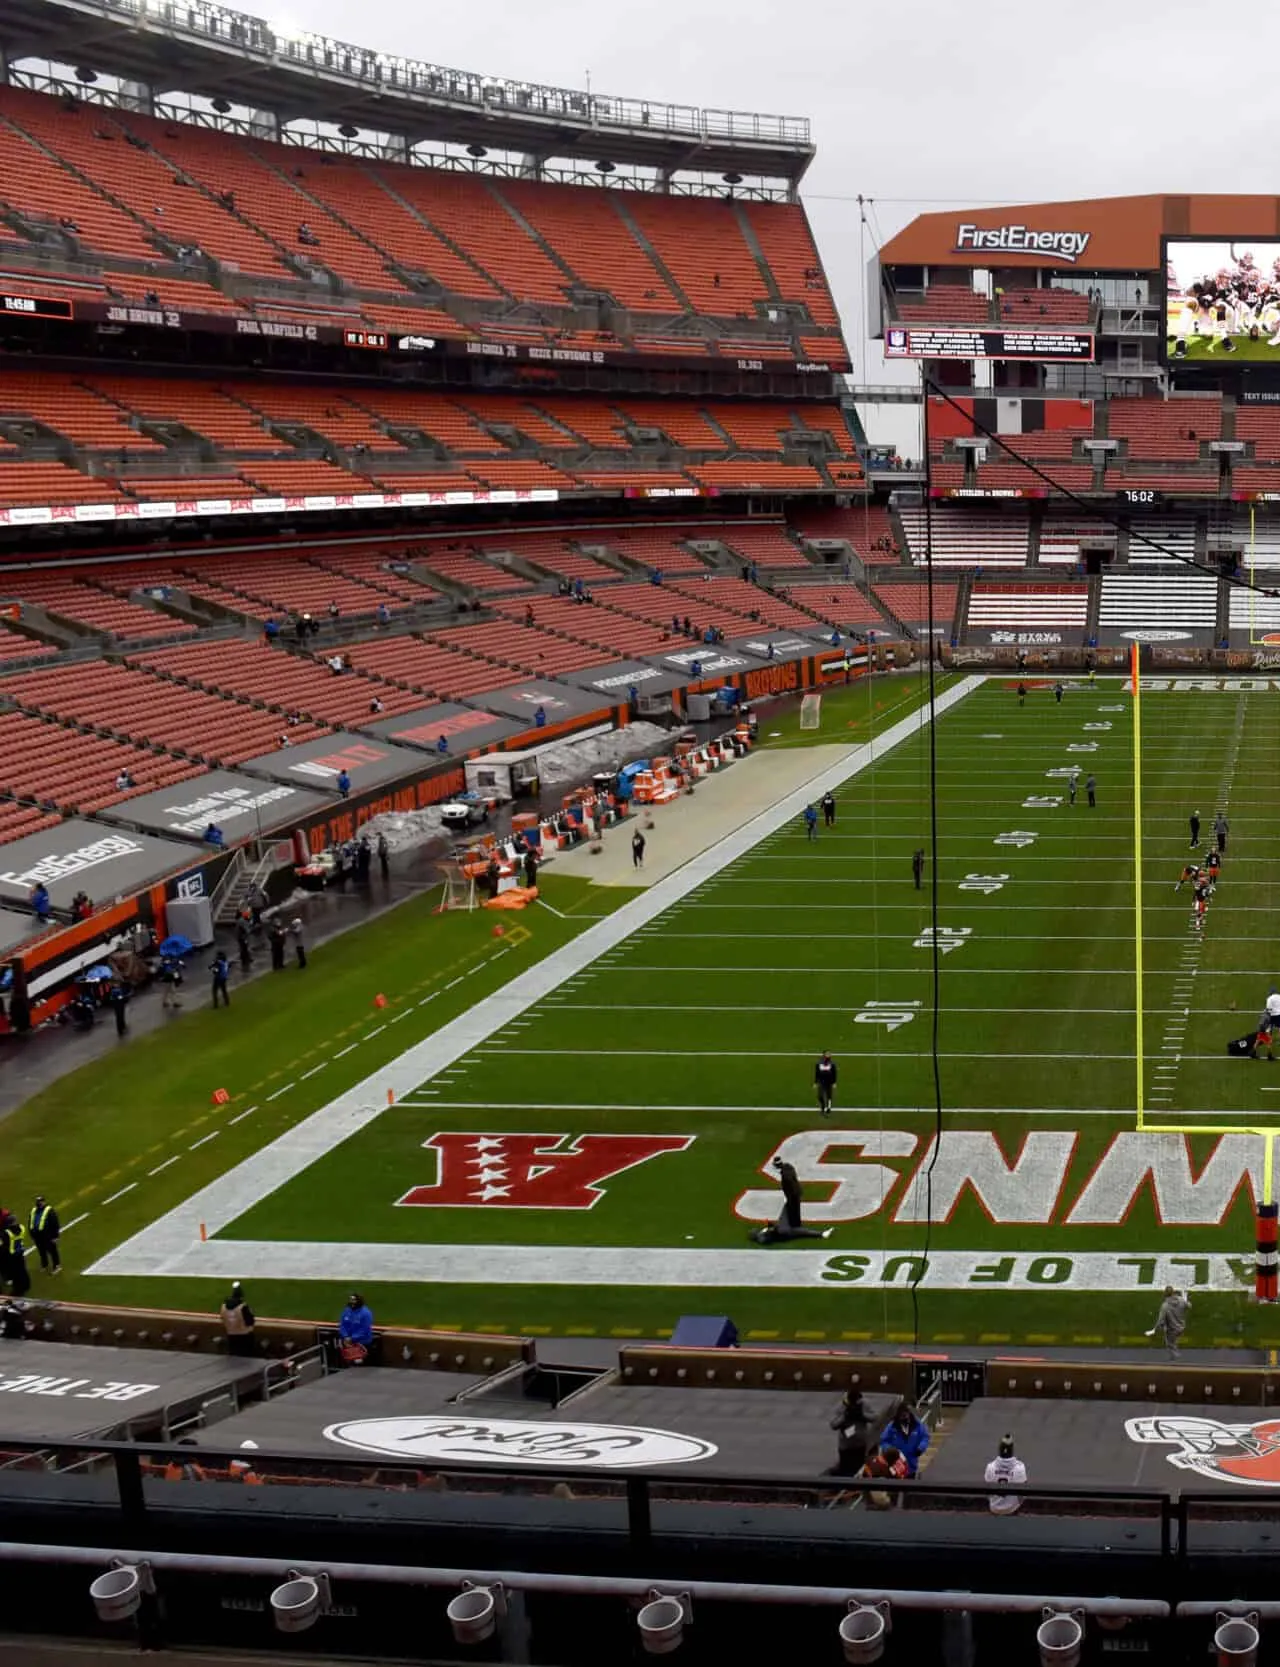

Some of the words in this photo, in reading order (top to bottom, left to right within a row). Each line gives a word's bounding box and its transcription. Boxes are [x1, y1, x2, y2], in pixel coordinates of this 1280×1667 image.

[956, 223, 1090, 258] FirstEnergy
[1244, 392, 1260, 400] TEXT
[746, 663, 796, 698] BROWNS
[0, 834, 138, 887] FirstEnergy
[912, 927, 973, 948] 20
[853, 1000, 923, 1024] 10
[822, 1254, 932, 1283] US
[967, 1256, 1073, 1284] OF
[1117, 1256, 1275, 1286] ALL
[73, 1382, 160, 1401] BE
[420, 1424, 642, 1462] Ford
